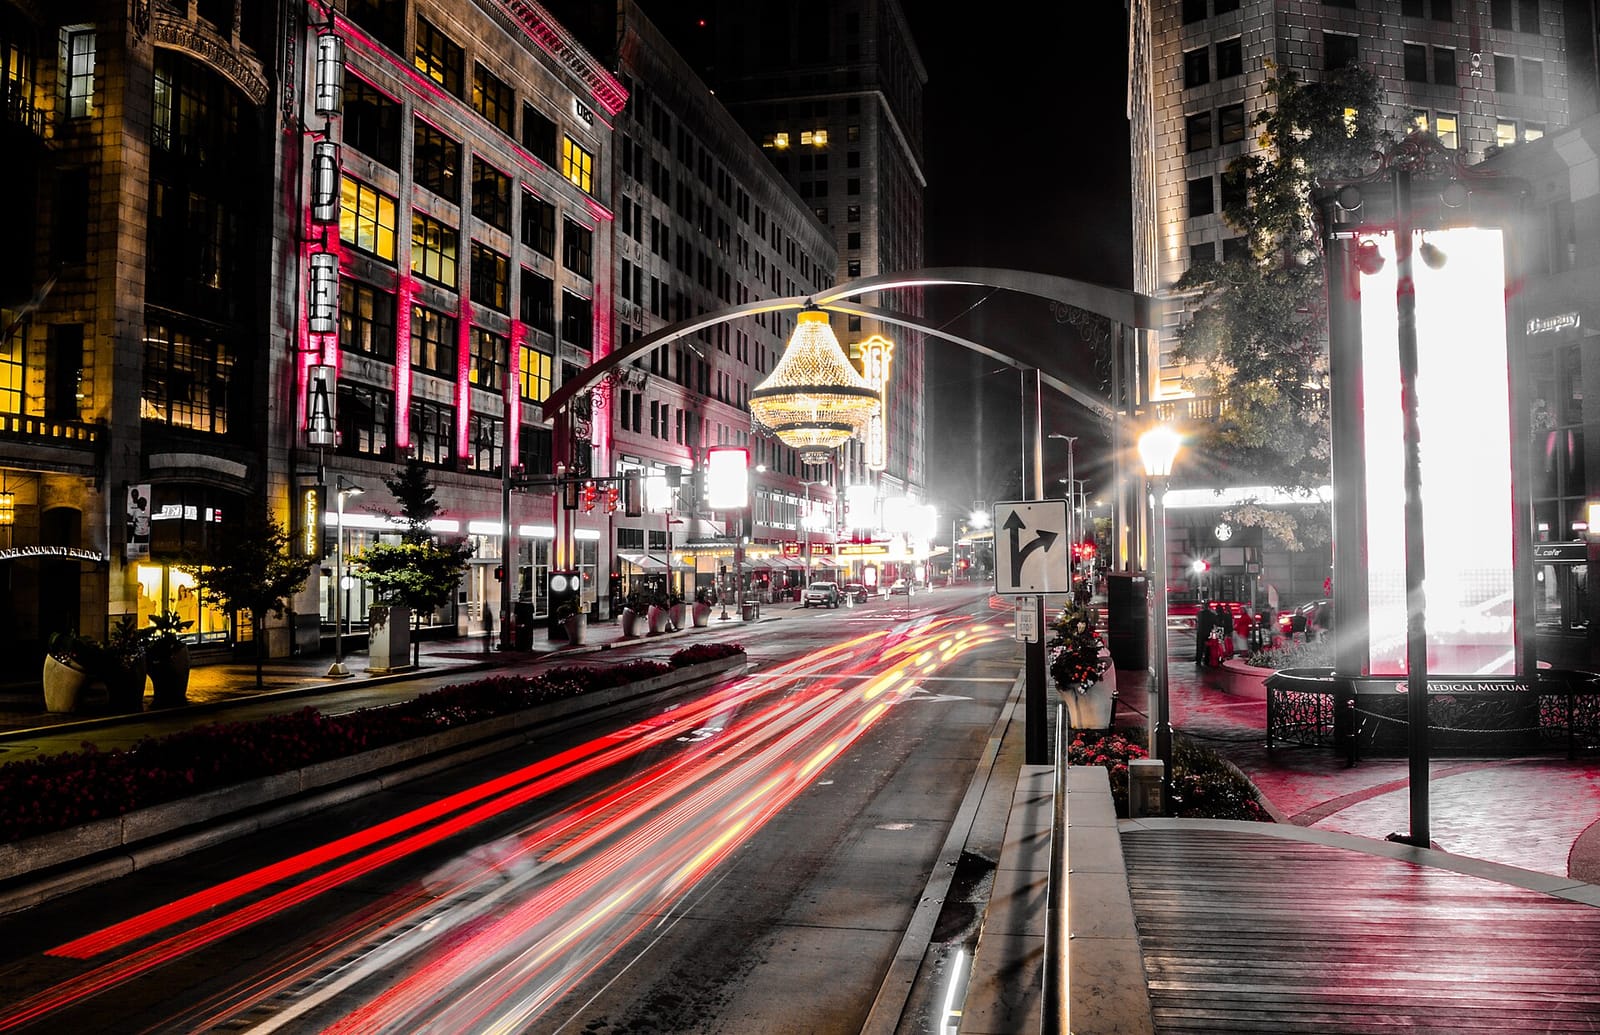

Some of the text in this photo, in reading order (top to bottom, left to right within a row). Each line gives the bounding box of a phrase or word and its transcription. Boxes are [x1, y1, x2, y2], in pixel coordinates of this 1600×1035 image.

[306, 490, 317, 555] CENTER
[22, 545, 67, 557] COMMUNITY
[69, 547, 102, 561] BUILDING
